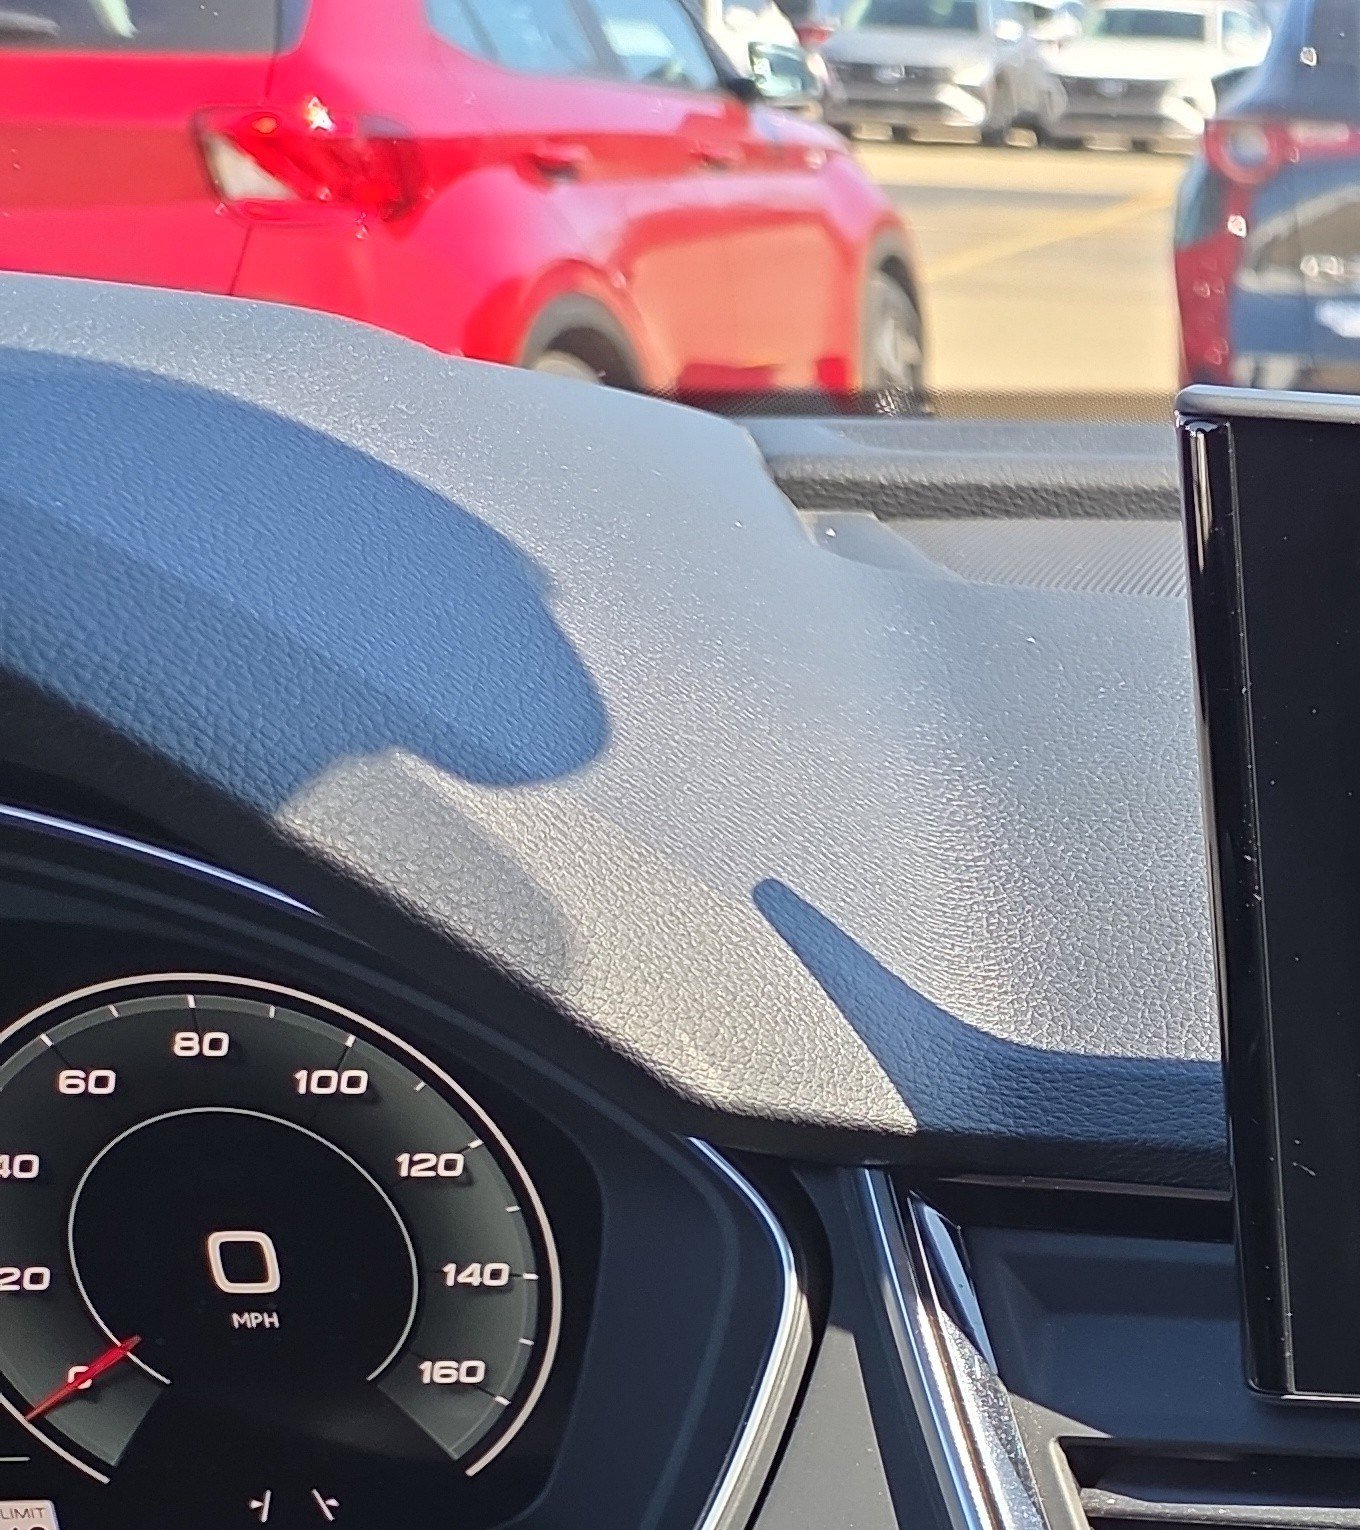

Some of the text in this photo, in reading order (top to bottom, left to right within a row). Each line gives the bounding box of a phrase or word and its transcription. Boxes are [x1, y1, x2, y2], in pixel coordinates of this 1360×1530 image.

[173, 1031, 230, 1057] 80
[58, 1069, 117, 1095] 60
[294, 1069, 369, 1095] 100
[396, 1152, 465, 1178] 120
[207, 1230, 281, 1294] 0
[442, 1262, 511, 1287] 140
[231, 1311, 280, 1329] MPH
[419, 1359, 486, 1384] 160
